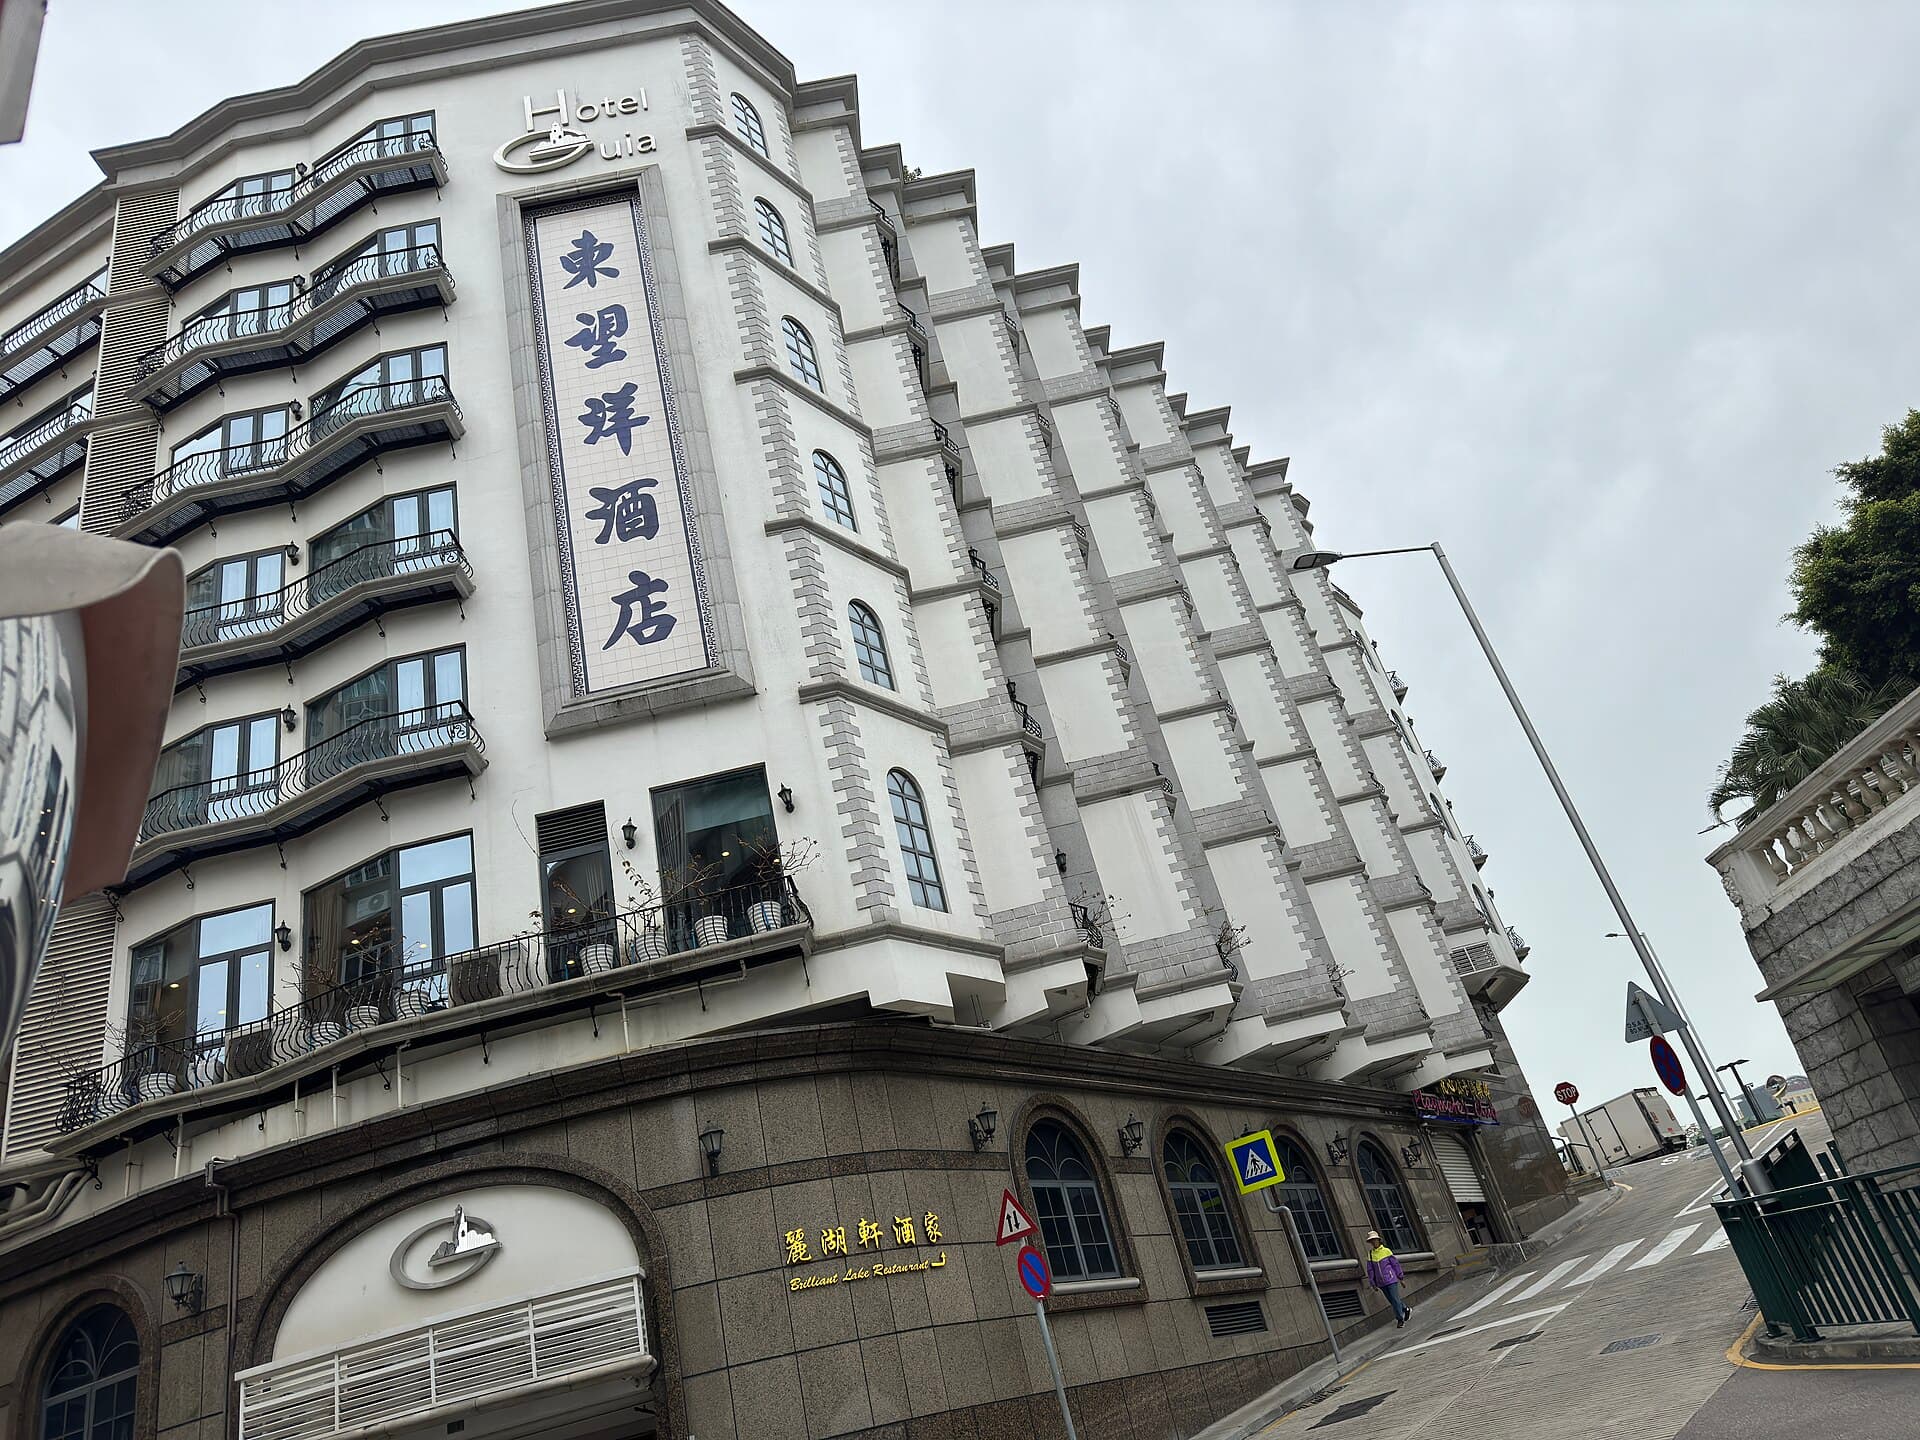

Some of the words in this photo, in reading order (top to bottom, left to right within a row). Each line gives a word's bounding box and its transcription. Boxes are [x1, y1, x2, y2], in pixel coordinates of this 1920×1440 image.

[523, 88, 649, 132] Hotel
[493, 127, 657, 174] Guia
[558, 229, 678, 651] 東望洋酒店
[1556, 1087, 1576, 1101] STOP
[785, 1212, 943, 1264] 麗湖軒酒家
[789, 1274, 838, 1291] Brilliant
[843, 1267, 870, 1281] Lake
